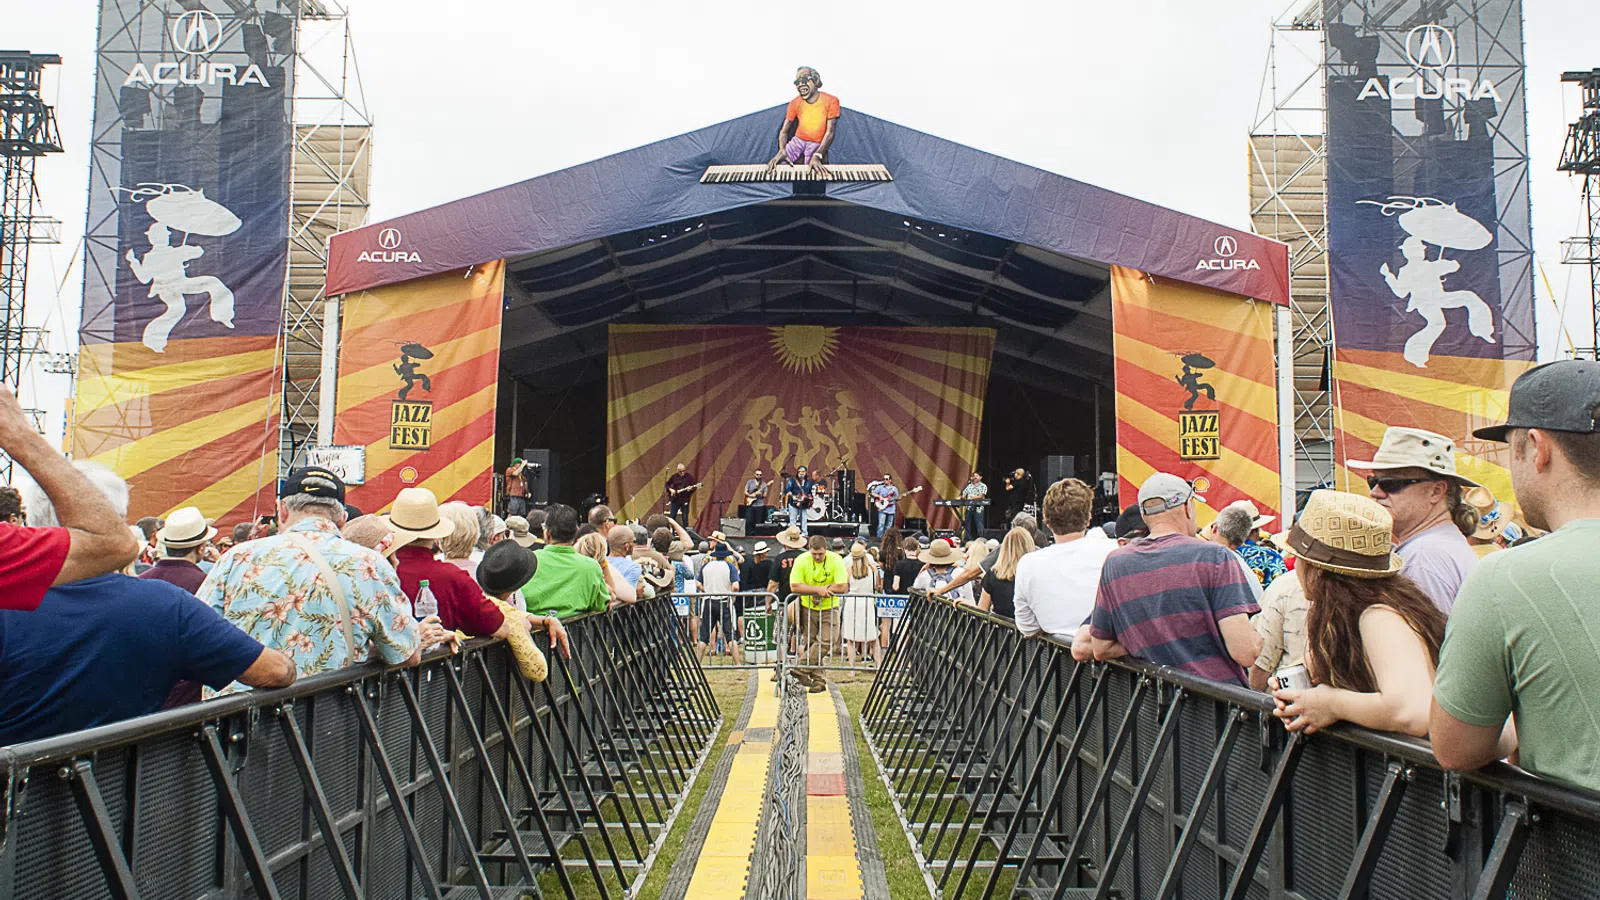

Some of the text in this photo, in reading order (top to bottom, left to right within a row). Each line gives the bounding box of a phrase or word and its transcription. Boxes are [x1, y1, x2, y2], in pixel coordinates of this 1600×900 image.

[123, 62, 271, 88] ACURA
[1355, 77, 1503, 103] ACURA
[356, 251, 423, 263] ACURA
[1194, 259, 1261, 270] ACURA
[392, 404, 431, 425] JAZZ
[1180, 415, 1218, 436] JAZZ
[391, 427, 431, 446] FEST
[1181, 437, 1219, 456] FEST
